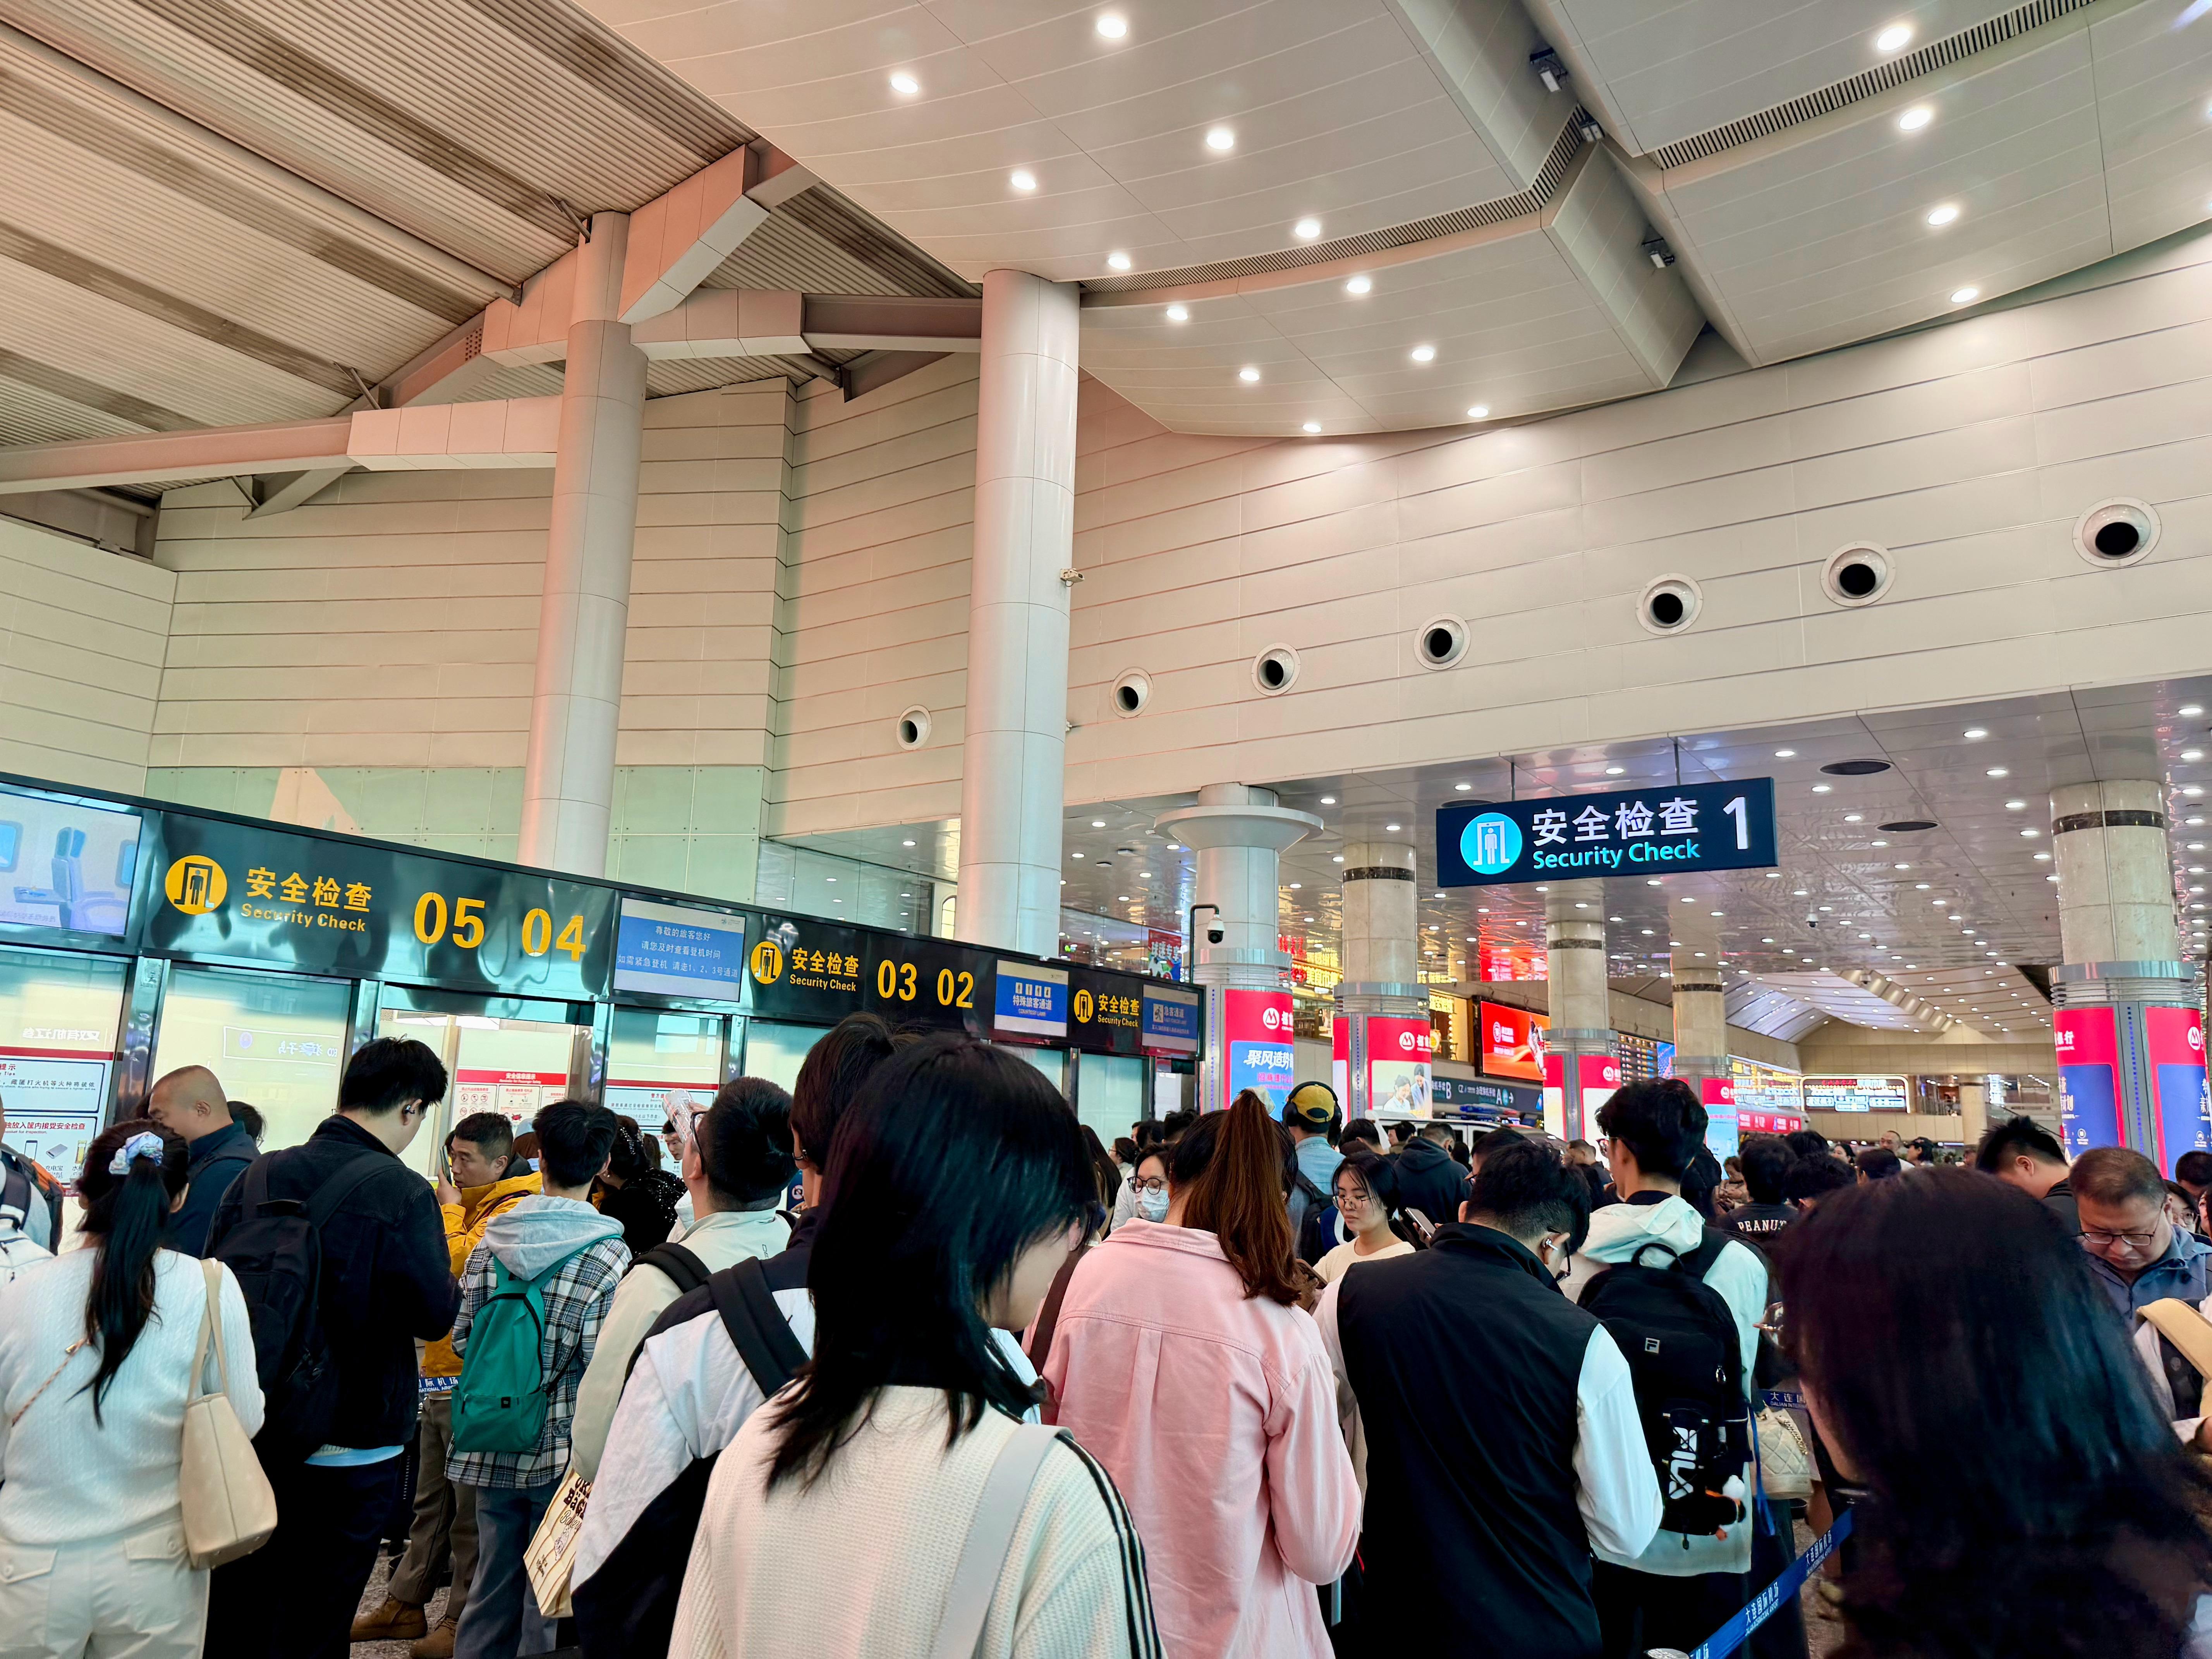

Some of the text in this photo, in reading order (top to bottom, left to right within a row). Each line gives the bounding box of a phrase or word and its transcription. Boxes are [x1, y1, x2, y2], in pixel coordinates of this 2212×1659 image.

[1532, 797, 1699, 847] 安全检查
[1723, 797, 1748, 850] 1
[1534, 839, 1700, 869] Security Check
[246, 867, 372, 912] 安全检查
[241, 903, 366, 931] Security Check
[414, 891, 588, 961] 05 04
[655, 926, 711, 941] 尊敬的旅客您好
[618, 954, 667, 969] 如需紧急登机
[641, 941, 721, 960] 请您及时查看登机时间
[792, 947, 859, 977] 安全检查
[790, 974, 856, 991] Security Check
[878, 959, 974, 1008] 03 02
[1013, 994, 1052, 1010] 特殊旅客通道
[1099, 993, 1139, 1016] 安全检查
[1098, 1014, 1138, 1027] Security Check
[2054, 1030, 2074, 1045] 银行
[1446, 1082, 1451, 1099] B
[1496, 1088, 1502, 1104] A
[1669, 1427, 1697, 1499] FILA
